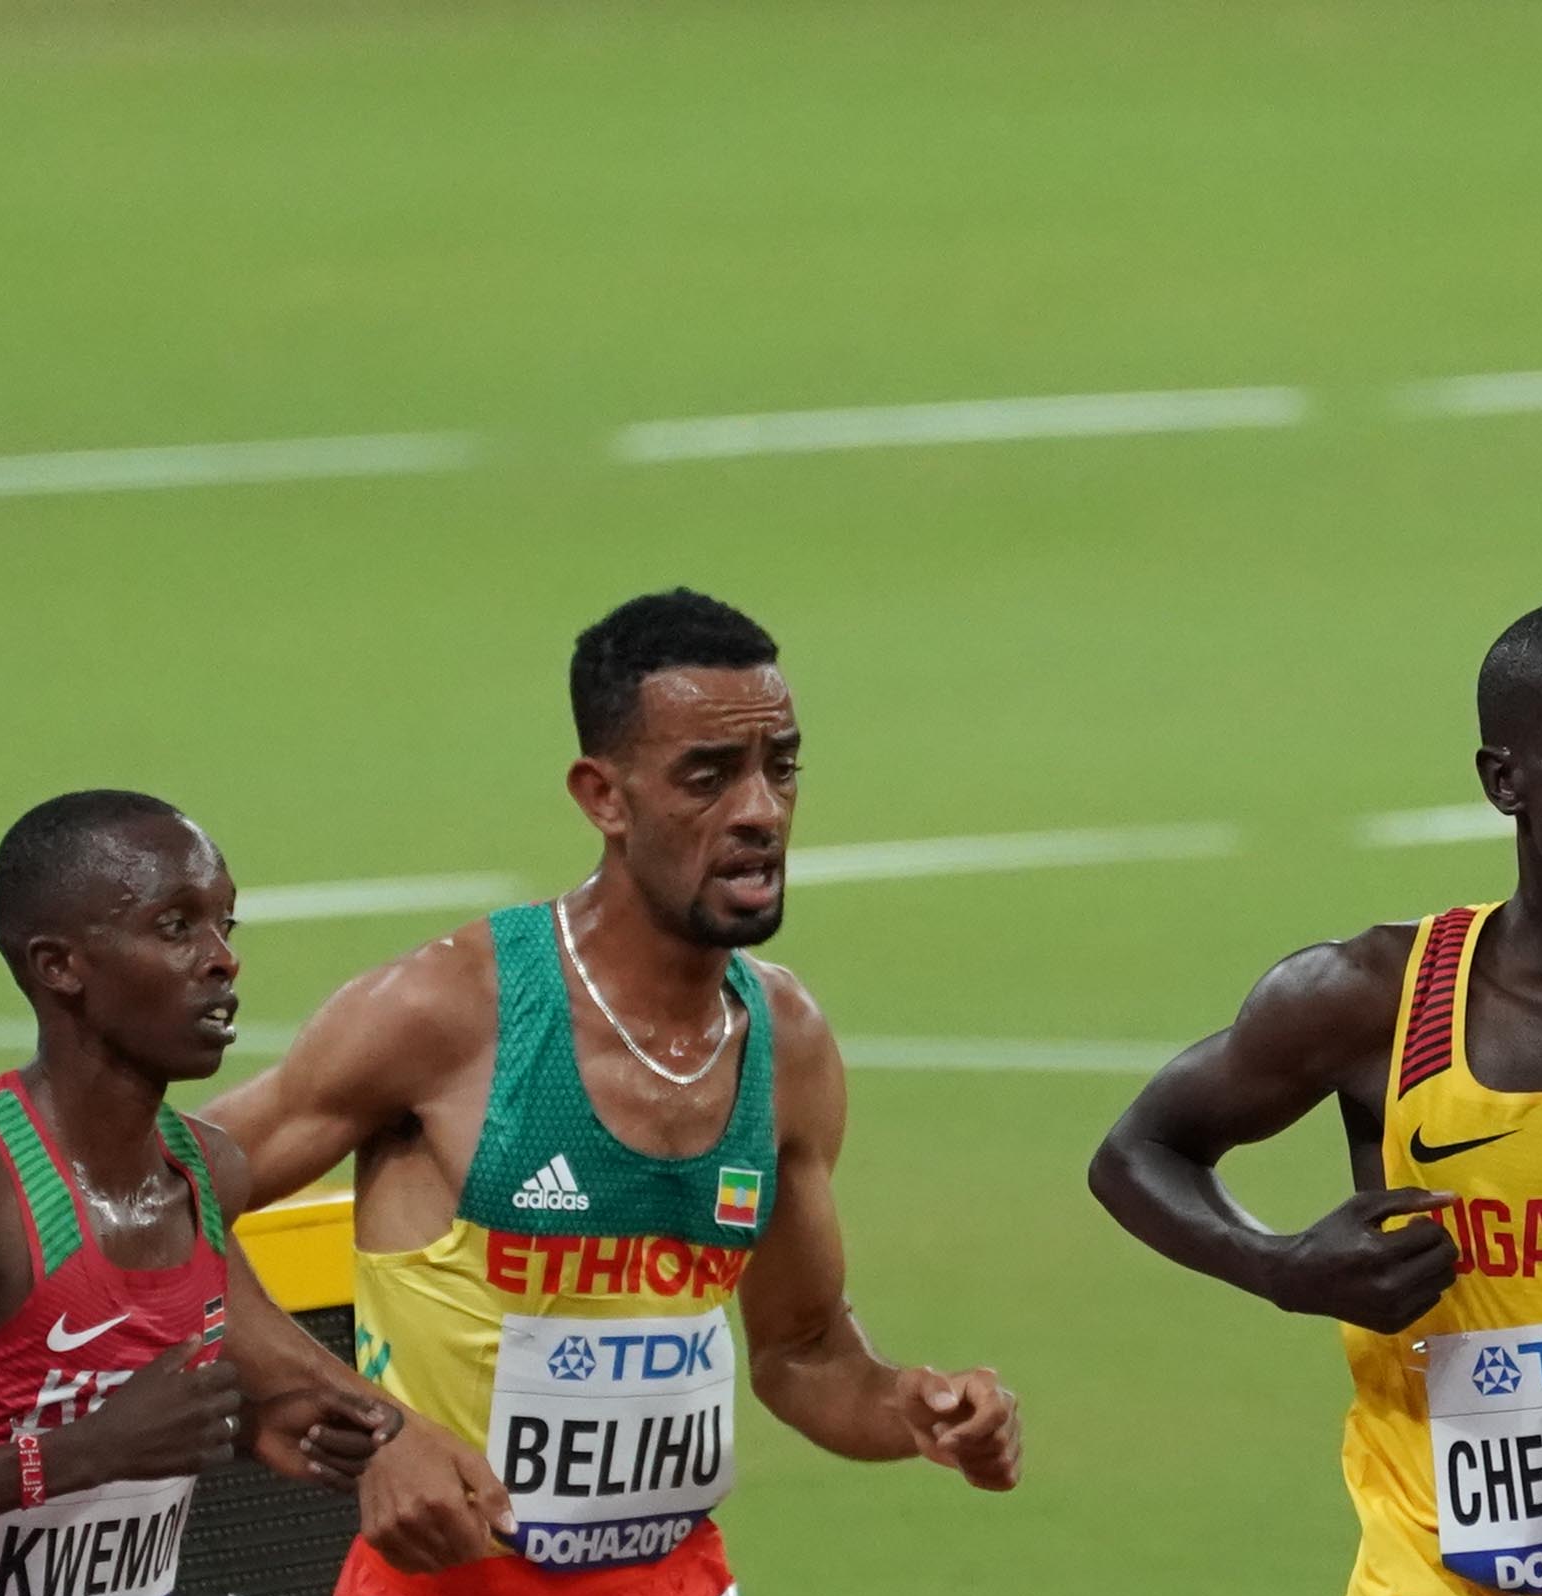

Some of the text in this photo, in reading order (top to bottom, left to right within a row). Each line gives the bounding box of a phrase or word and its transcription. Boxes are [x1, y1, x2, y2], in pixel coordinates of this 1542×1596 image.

[512, 1189, 590, 1213] adidas
[598, 1324, 718, 1383] TDK
[503, 1404, 722, 1498] BELIHU
[525, 1518, 693, 1565] DOHA2019
